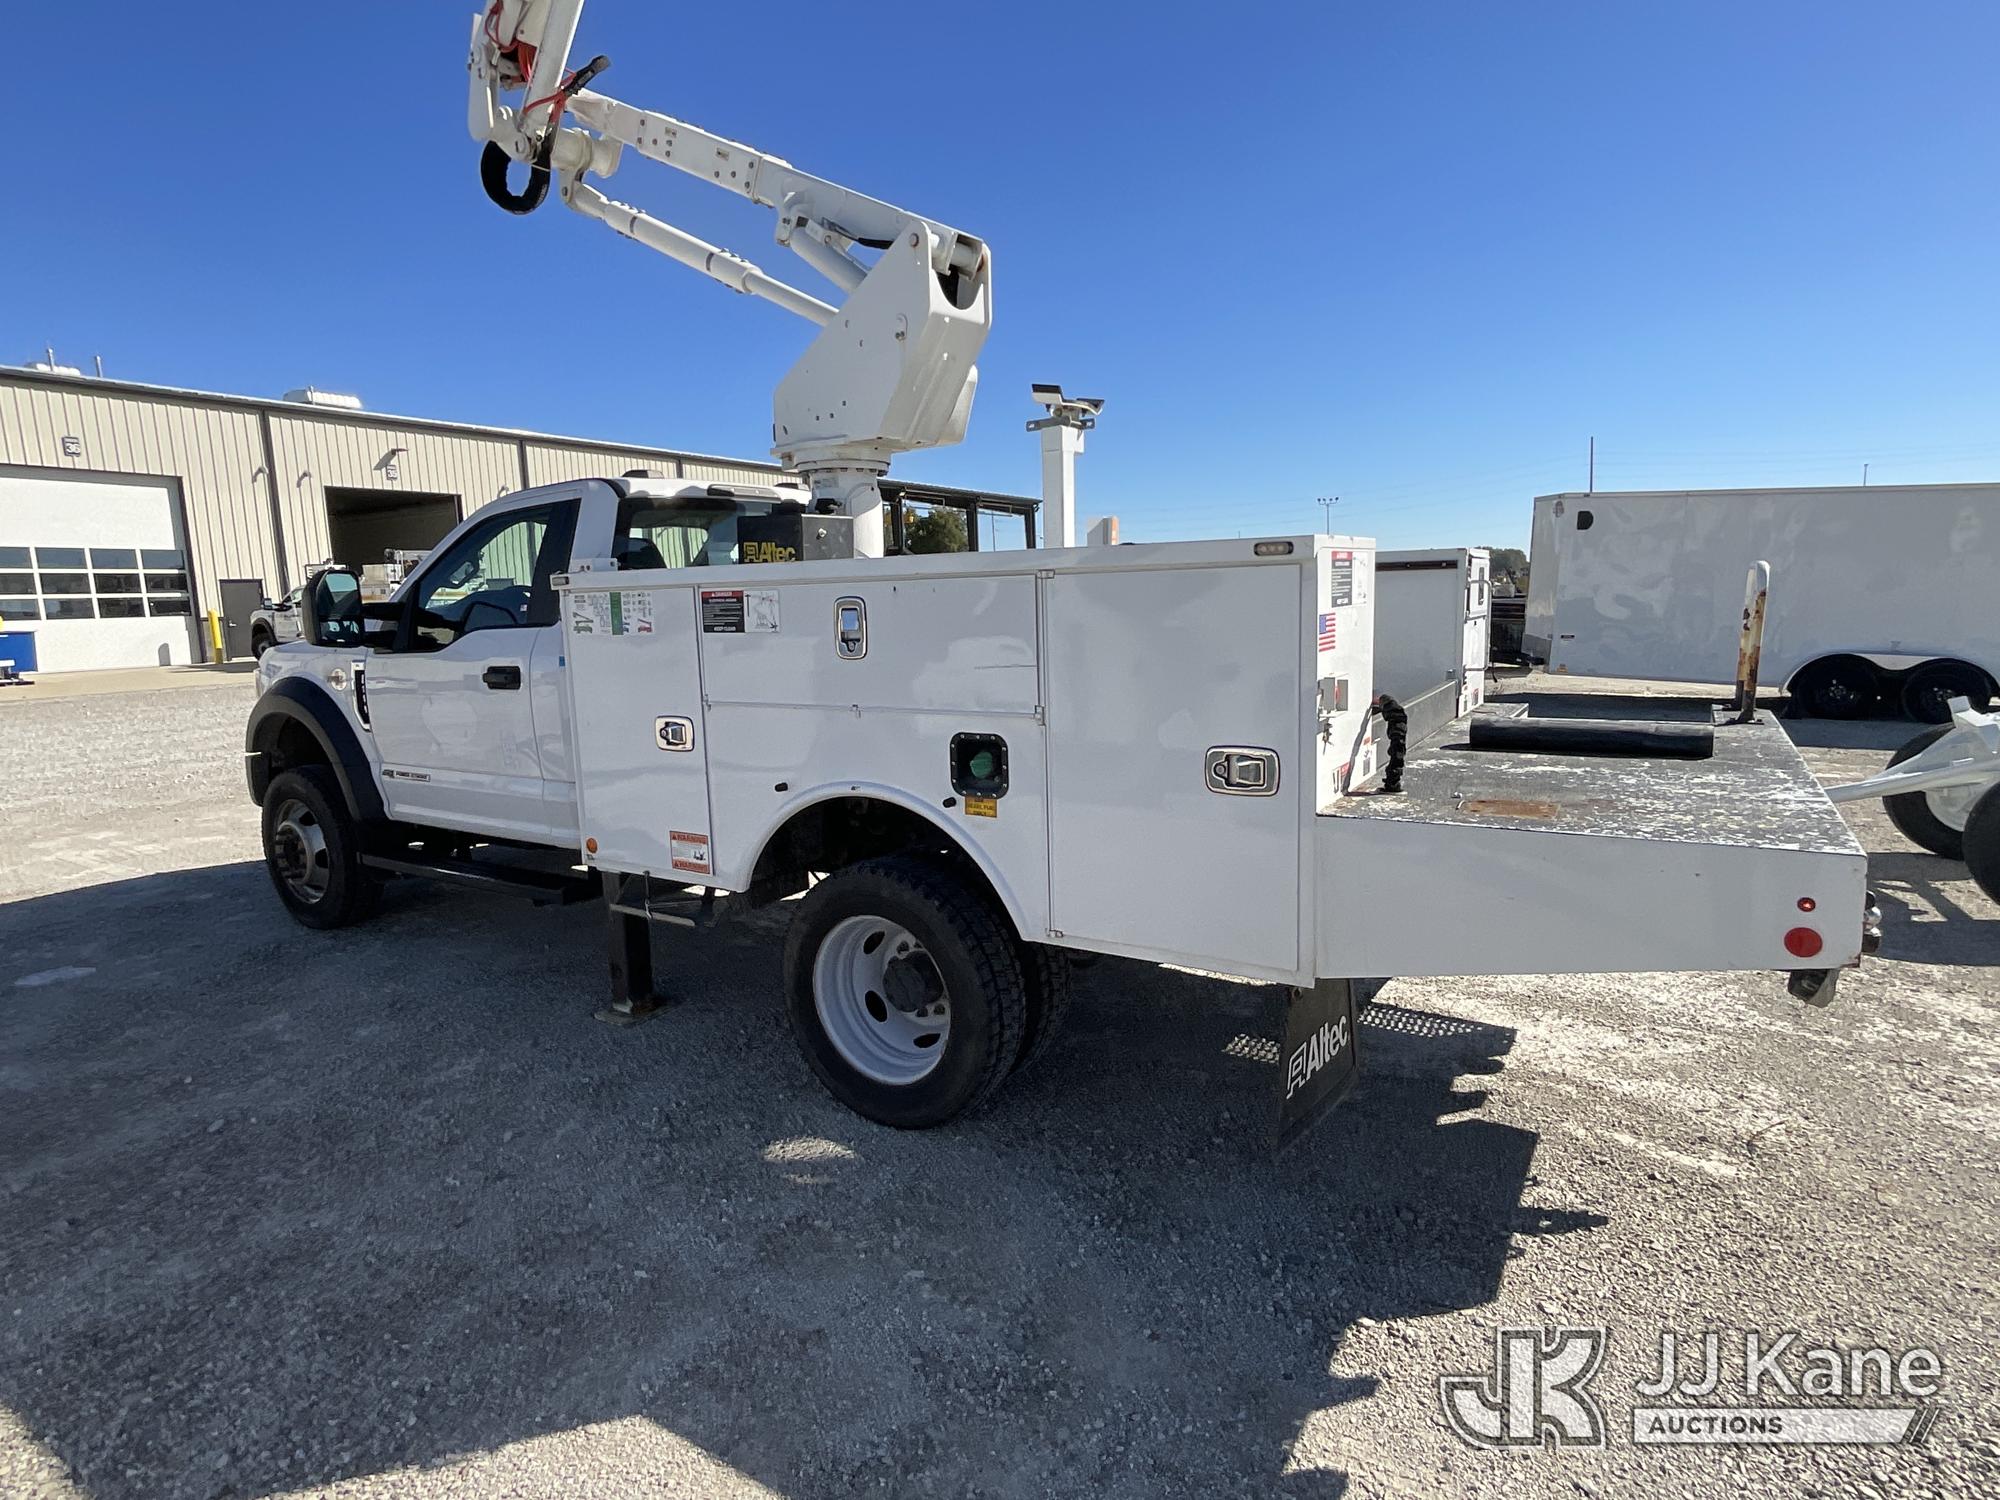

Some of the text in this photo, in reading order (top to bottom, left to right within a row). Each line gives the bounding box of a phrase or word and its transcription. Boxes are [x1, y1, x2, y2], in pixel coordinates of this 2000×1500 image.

[760, 542, 796, 563] Altec
[676, 833, 706, 844] WARNING
[1306, 1016, 1348, 1080] Altec
